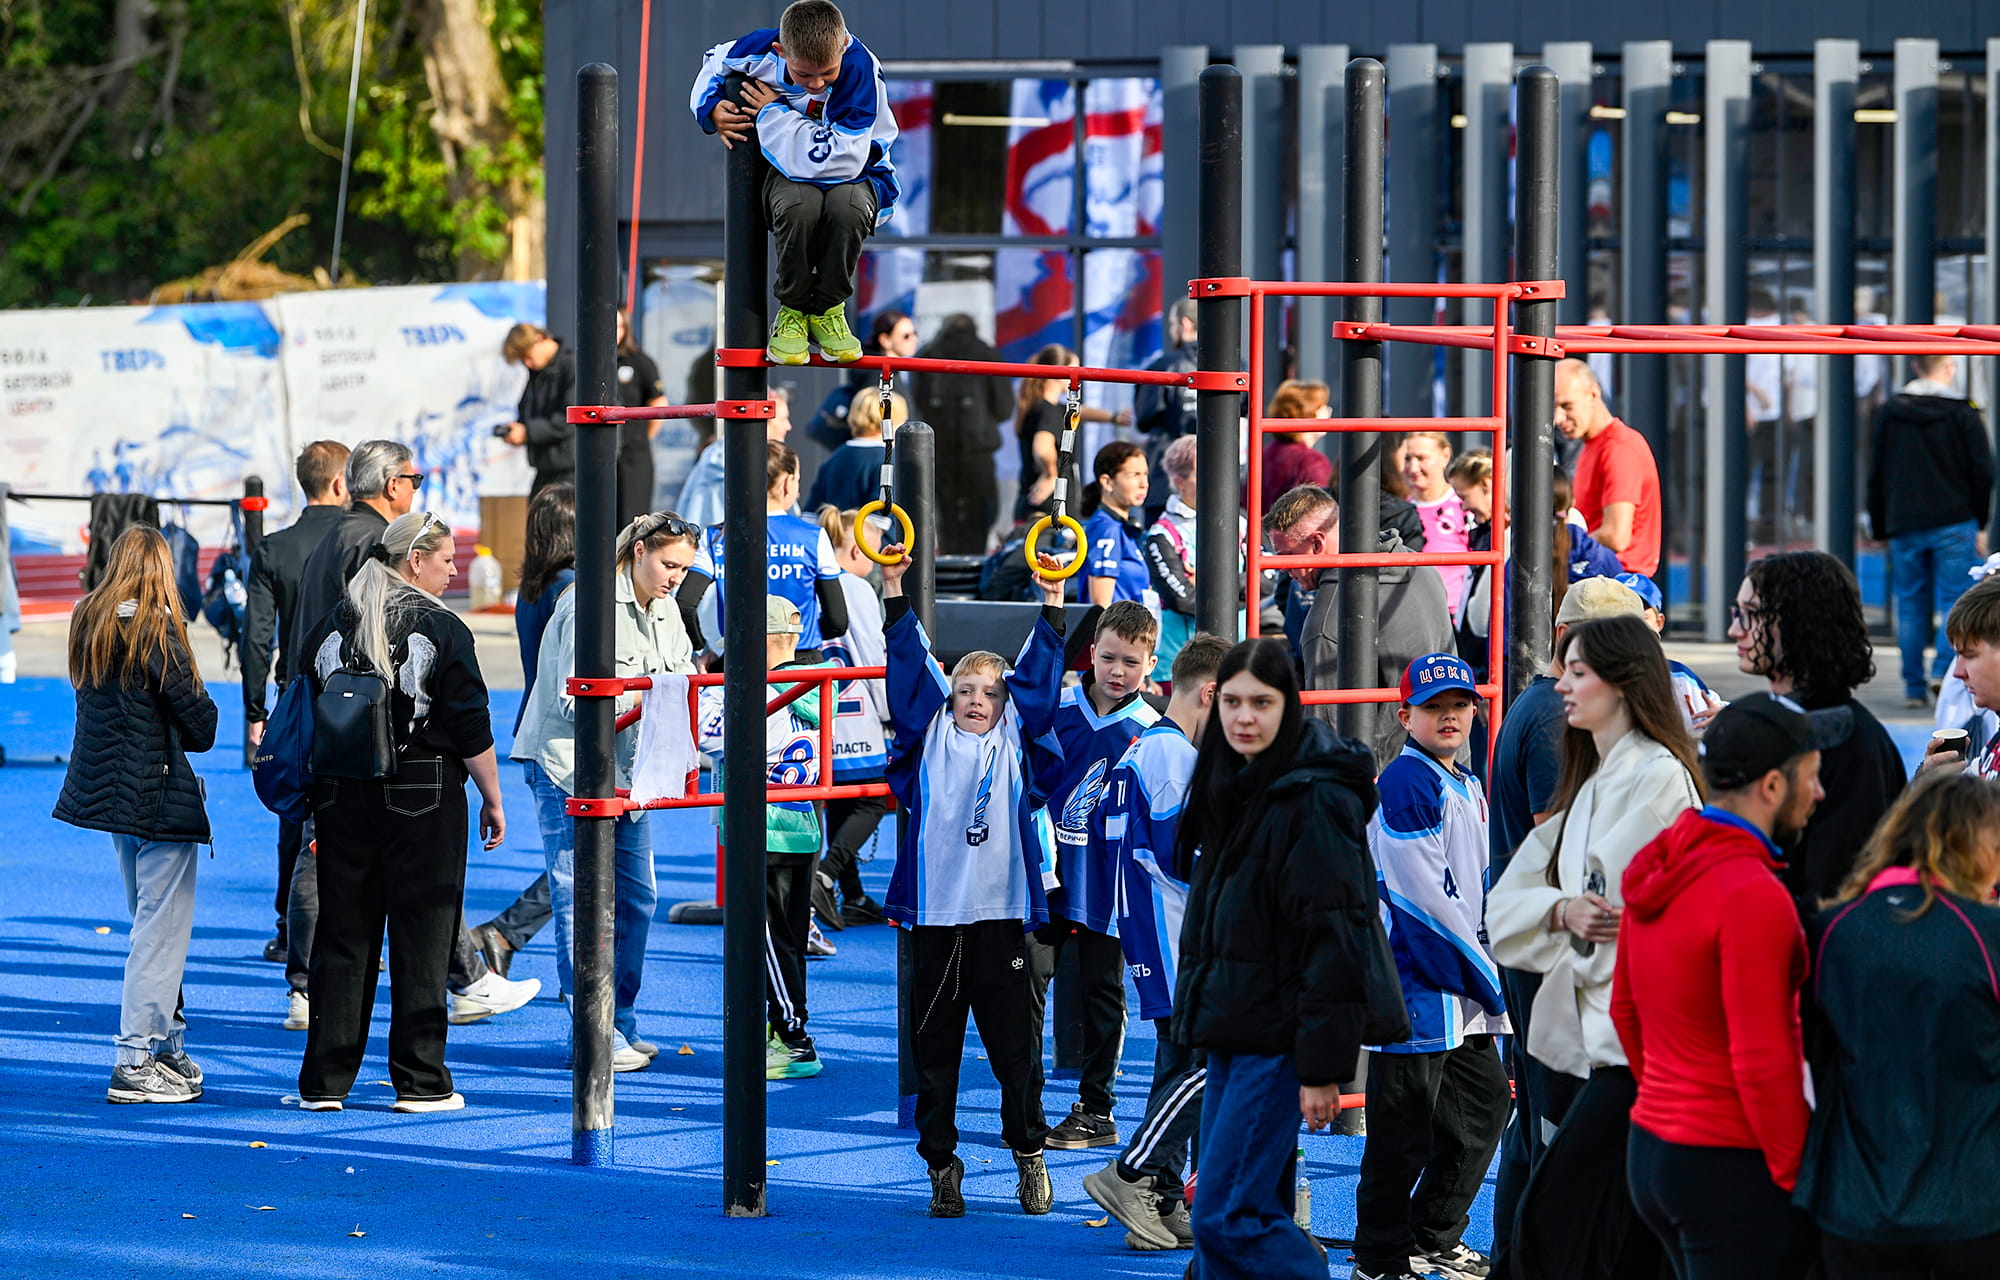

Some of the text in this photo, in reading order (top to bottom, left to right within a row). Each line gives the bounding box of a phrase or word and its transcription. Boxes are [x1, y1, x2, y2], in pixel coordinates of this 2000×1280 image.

[401, 326, 466, 346] ТВЕРЬ
[101, 350, 166, 373] ТВЕРЬ
[1097, 539, 1115, 558] 7
[1420, 666, 1470, 684] ЦСКА
[832, 741, 872, 755] ЛАСТЬ
[1443, 866, 1460, 900] 4
